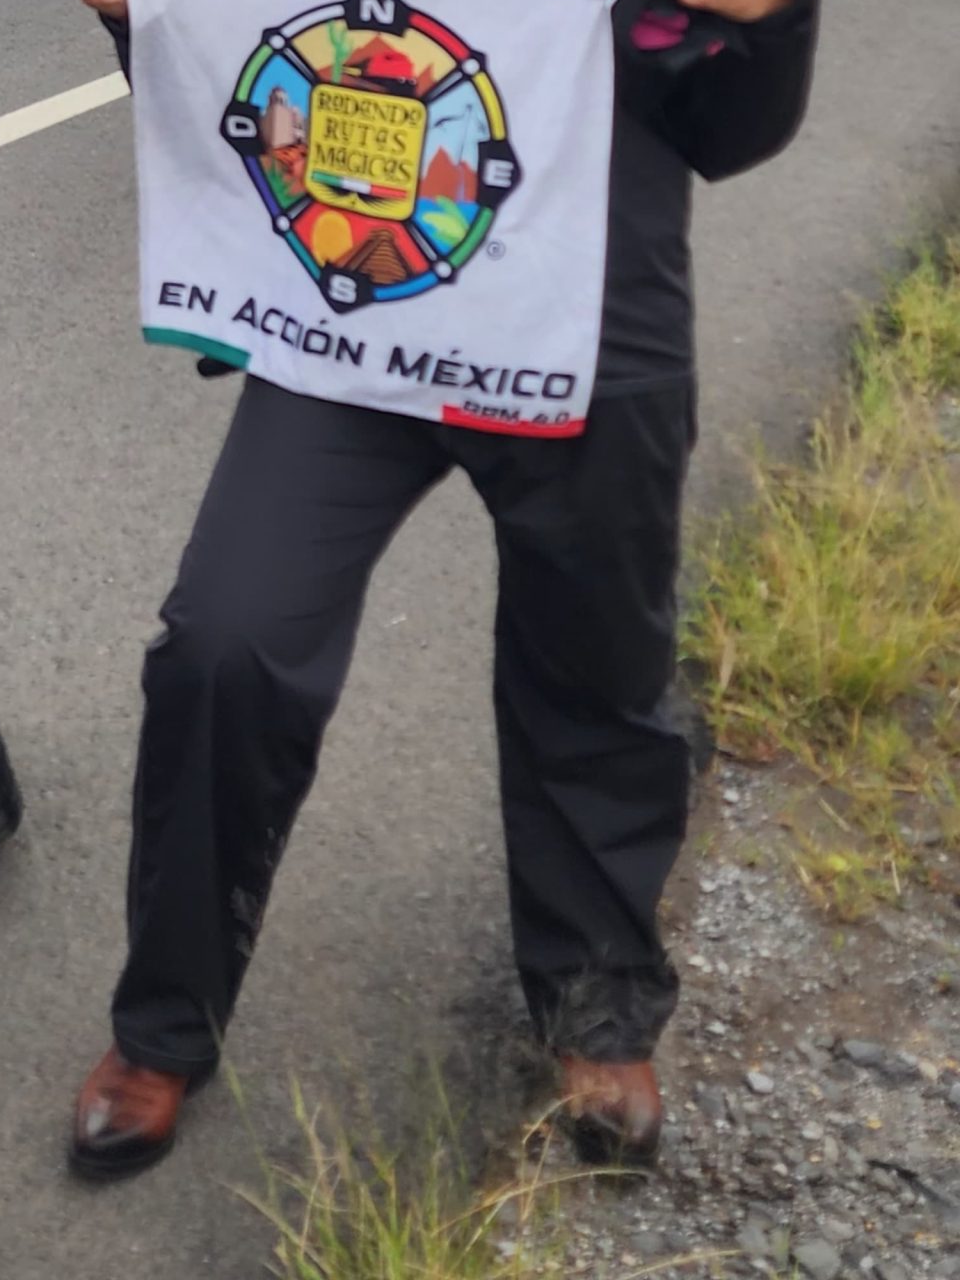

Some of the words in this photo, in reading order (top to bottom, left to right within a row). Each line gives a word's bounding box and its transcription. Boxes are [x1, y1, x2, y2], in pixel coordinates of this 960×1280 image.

[483, 159, 515, 188] E
[328, 273, 358, 304] S
[157, 281, 218, 315] EN
[232, 297, 367, 367] ACCIÓN
[386, 348, 579, 401] MÉXICO
